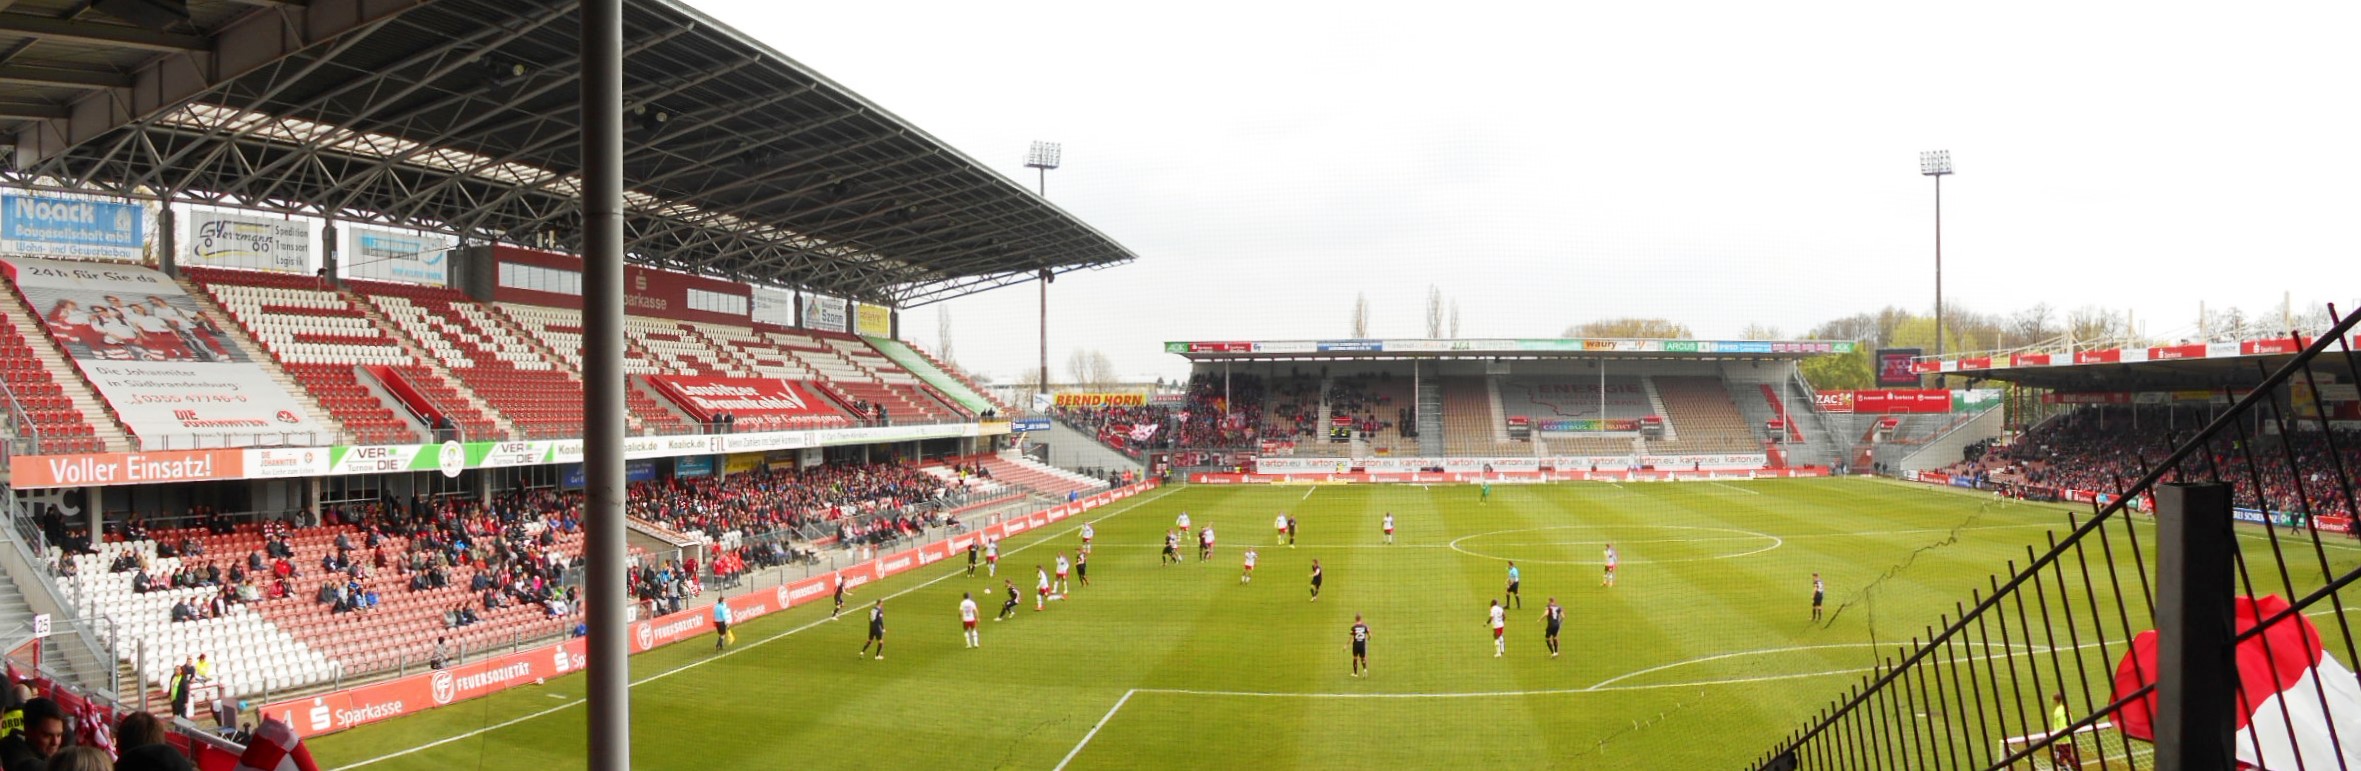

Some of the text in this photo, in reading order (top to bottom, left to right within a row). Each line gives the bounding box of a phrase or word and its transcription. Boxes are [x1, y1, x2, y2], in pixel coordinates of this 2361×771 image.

[15, 197, 95, 224] Noack
[15, 224, 104, 242] Baugesellschaft
[275, 225, 308, 238] Spedition
[15, 241, 46, 252] Wohn-
[69, 246, 131, 258] Gewerbebau
[276, 256, 304, 268] Logisik
[73, 269, 98, 280] für
[103, 271, 130, 281] Sie
[136, 274, 159, 284] da
[624, 292, 667, 310] parkasse
[1586, 340, 1617, 349] waury
[1666, 343, 1695, 351] ARCUS
[125, 368, 197, 377] Johanniter
[672, 382, 761, 396] Lausitzer
[1539, 383, 1642, 394] ENERGIE
[692, 395, 800, 410] Braunkohle
[1056, 394, 1101, 406] BERND
[1103, 394, 1144, 406] HORN
[1816, 394, 1838, 405] ZAC
[501, 443, 524, 453] VER
[623, 441, 658, 453] oalick.de
[356, 448, 386, 459] VER
[516, 453, 534, 464] DIE
[1725, 455, 1764, 463] karton.eu
[377, 459, 398, 471] DIE
[1259, 459, 1300, 468] karton.eu
[1306, 459, 1348, 467] karton.eu
[1353, 459, 1394, 467] karton.eu
[1494, 458, 1535, 466] karton.eu
[1588, 456, 1629, 465] karton.eu
[1634, 457, 1675, 465] karton.eu
[1680, 456, 1720, 464] karton.eu
[49, 453, 213, 484] Voller Einsatz!
[733, 604, 767, 622] Sparkasse
[37, 619, 50, 633] 25
[456, 661, 532, 691] FEUERSOZIETÄT
[335, 700, 403, 727] Sparkasse
